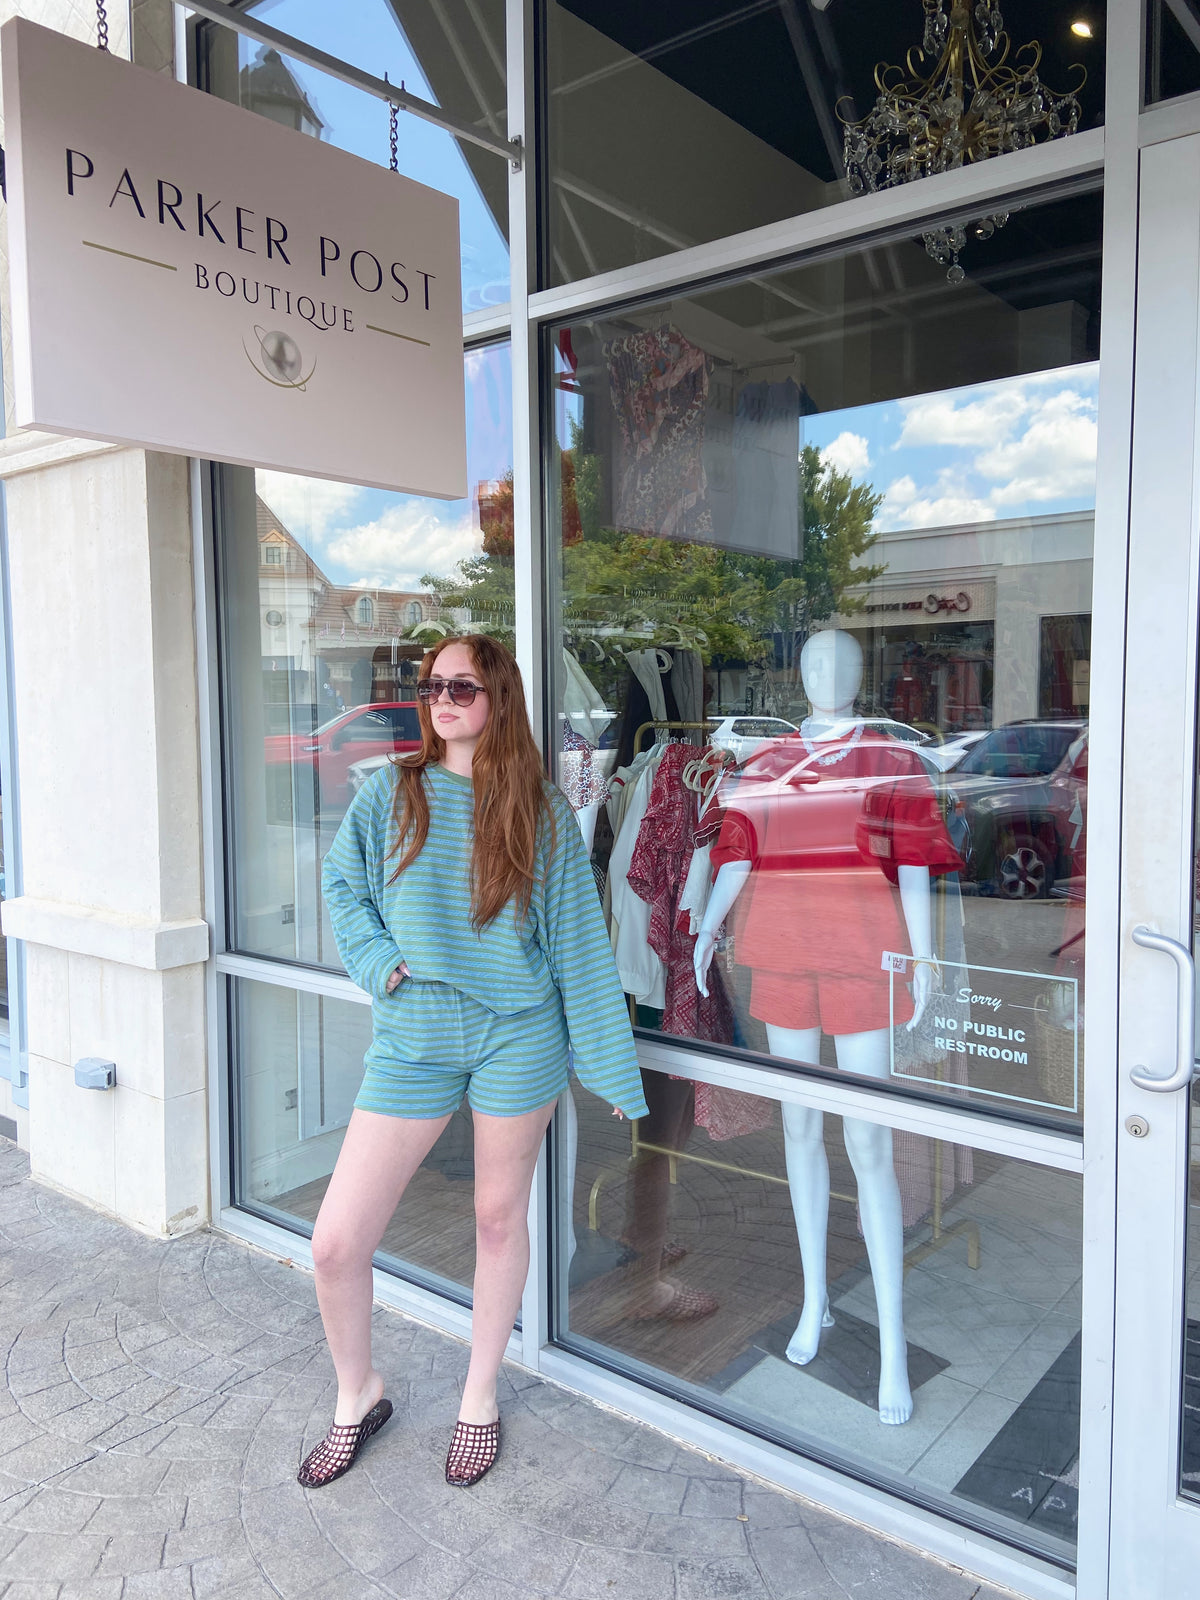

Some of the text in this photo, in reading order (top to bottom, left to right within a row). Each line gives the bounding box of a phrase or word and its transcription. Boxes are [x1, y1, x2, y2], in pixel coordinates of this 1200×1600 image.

[65, 148, 437, 311] PARKER POST
[194, 263, 355, 333] BOUTIQUE
[955, 987, 1002, 1012] Sorry
[934, 1016, 1026, 1043] NO PUBLIC
[934, 1036, 1028, 1065] RESTROOM
